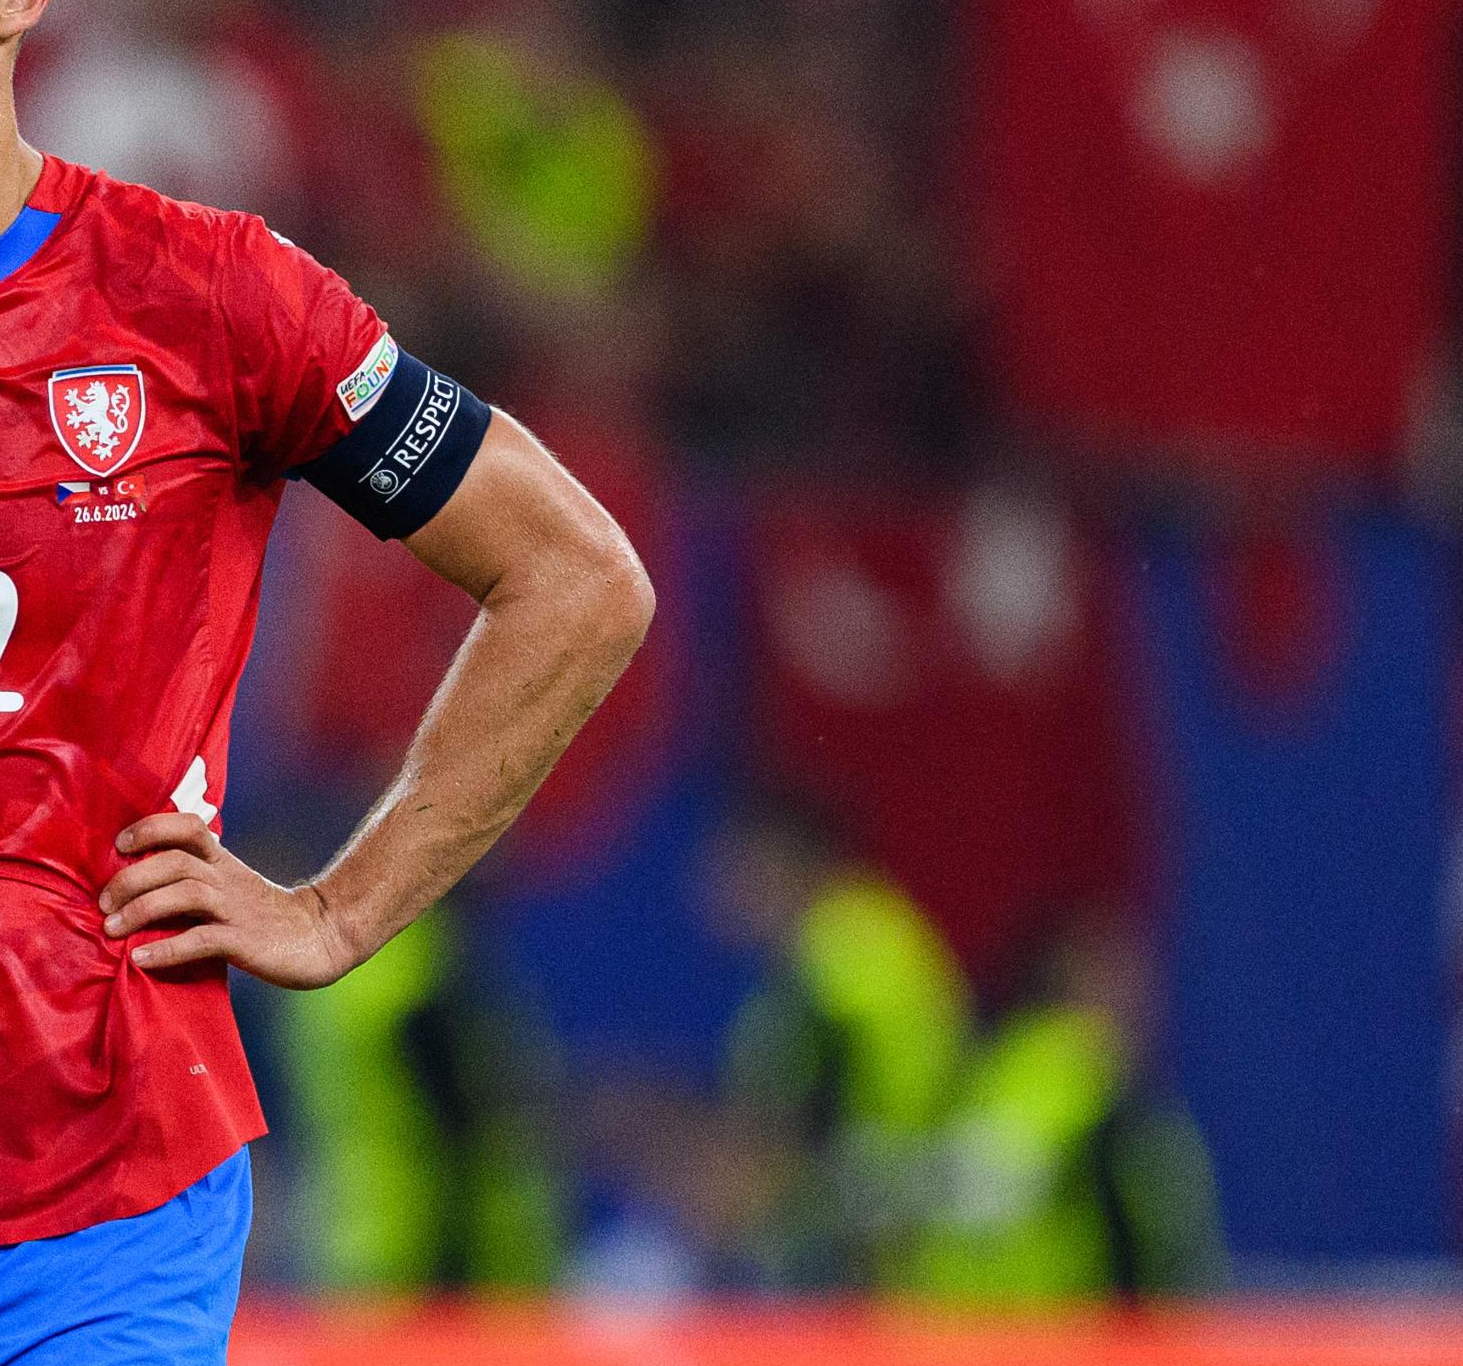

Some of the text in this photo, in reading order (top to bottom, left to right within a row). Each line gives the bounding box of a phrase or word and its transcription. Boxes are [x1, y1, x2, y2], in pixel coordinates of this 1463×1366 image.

[340, 370, 366, 395] UEFA
[393, 375, 455, 469] RESPECT
[74, 503, 137, 523] 26.6.2024
